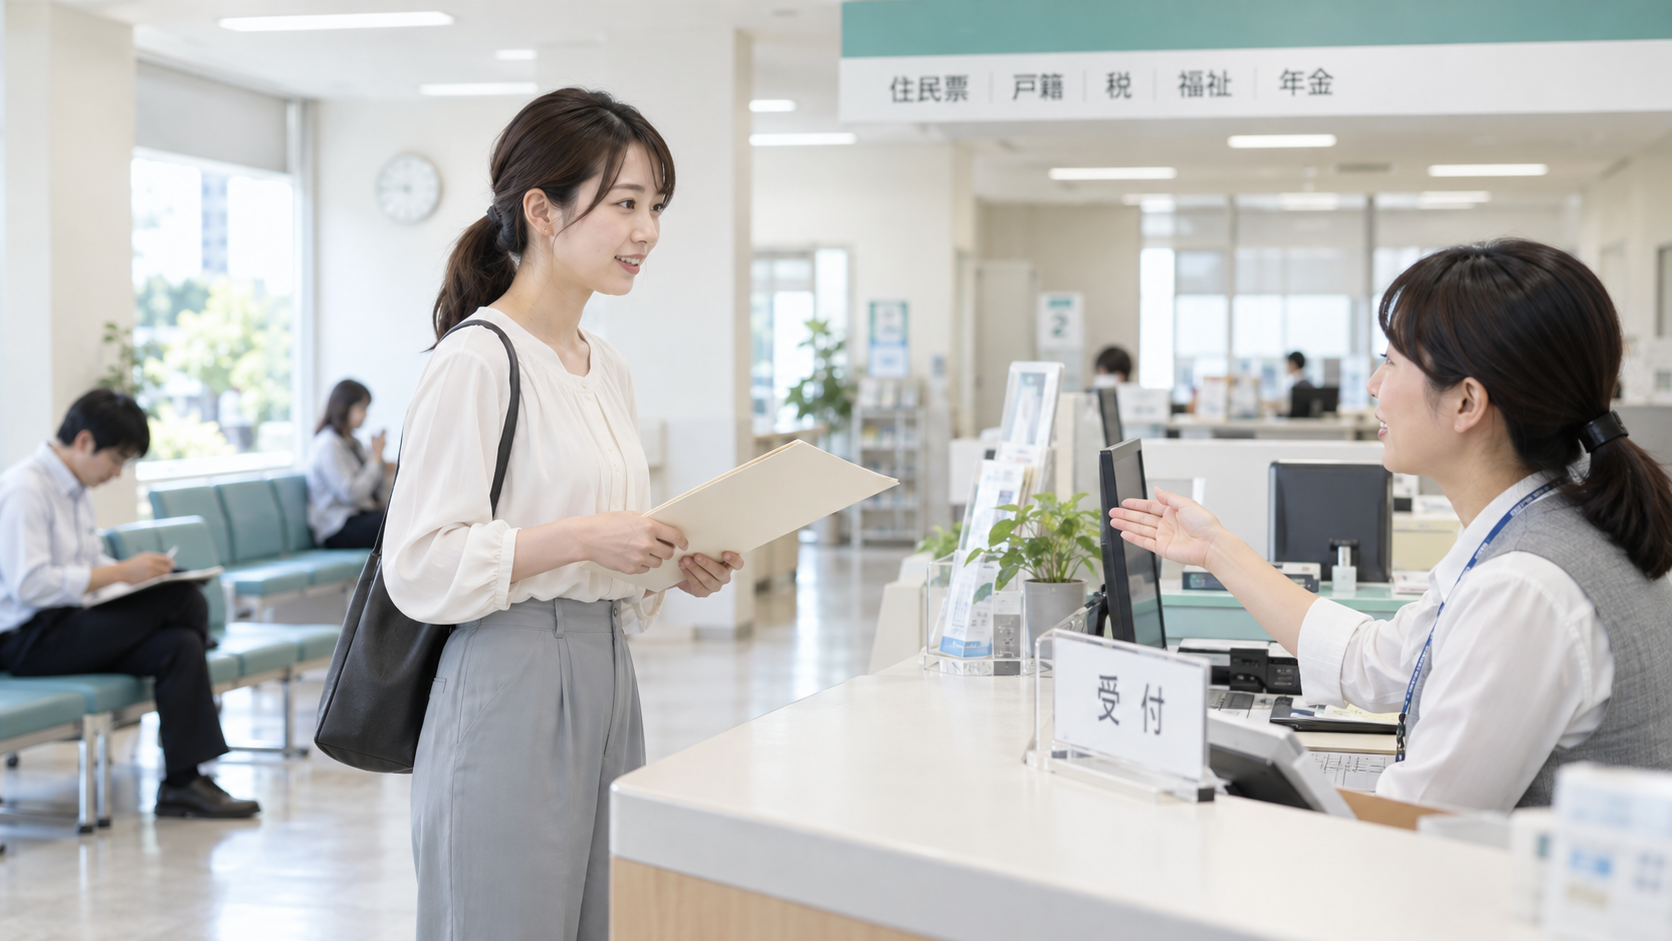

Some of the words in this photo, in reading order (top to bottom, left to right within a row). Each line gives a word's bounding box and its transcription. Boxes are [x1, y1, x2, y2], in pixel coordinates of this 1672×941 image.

[889, 74, 969, 104] 住民票
[1011, 72, 1065, 102] 戸籍
[1105, 71, 1133, 100] 税
[1177, 69, 1232, 98] 福祉
[1279, 67, 1335, 97] 年金
[1097, 674, 1166, 736] 受付
